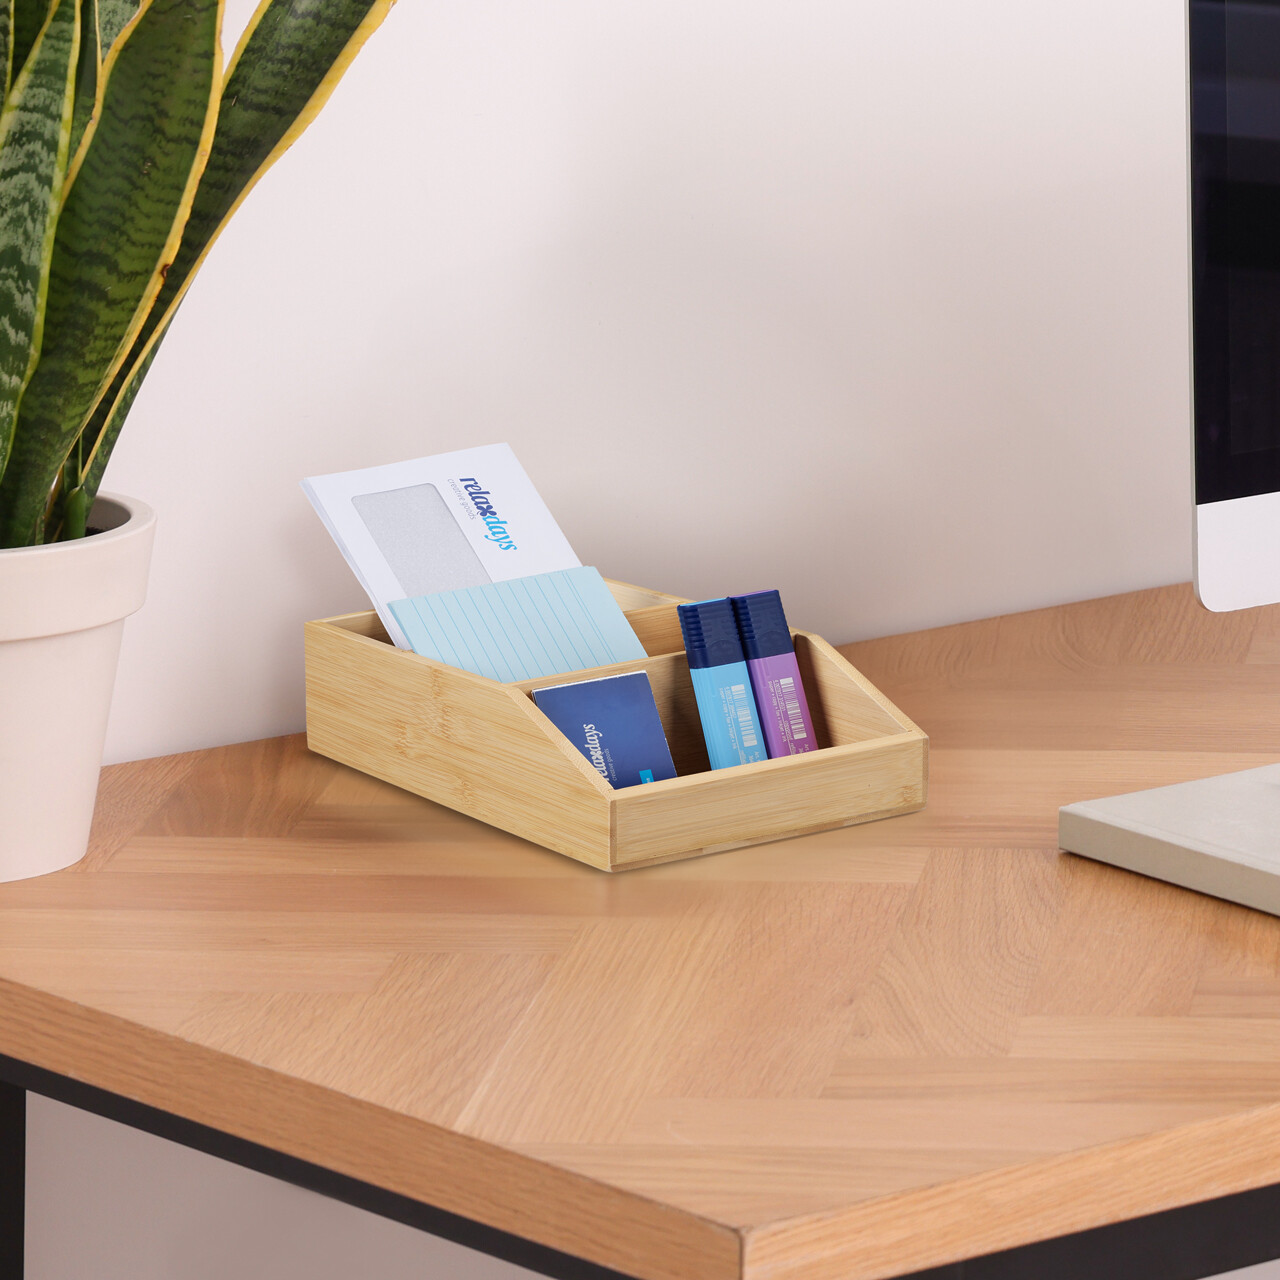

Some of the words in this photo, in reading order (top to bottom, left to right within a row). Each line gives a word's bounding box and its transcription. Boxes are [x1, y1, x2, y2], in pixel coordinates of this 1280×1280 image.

[447, 478, 466, 501] creative
[459, 500, 477, 521] goods
[459, 477, 518, 551] relaxdays
